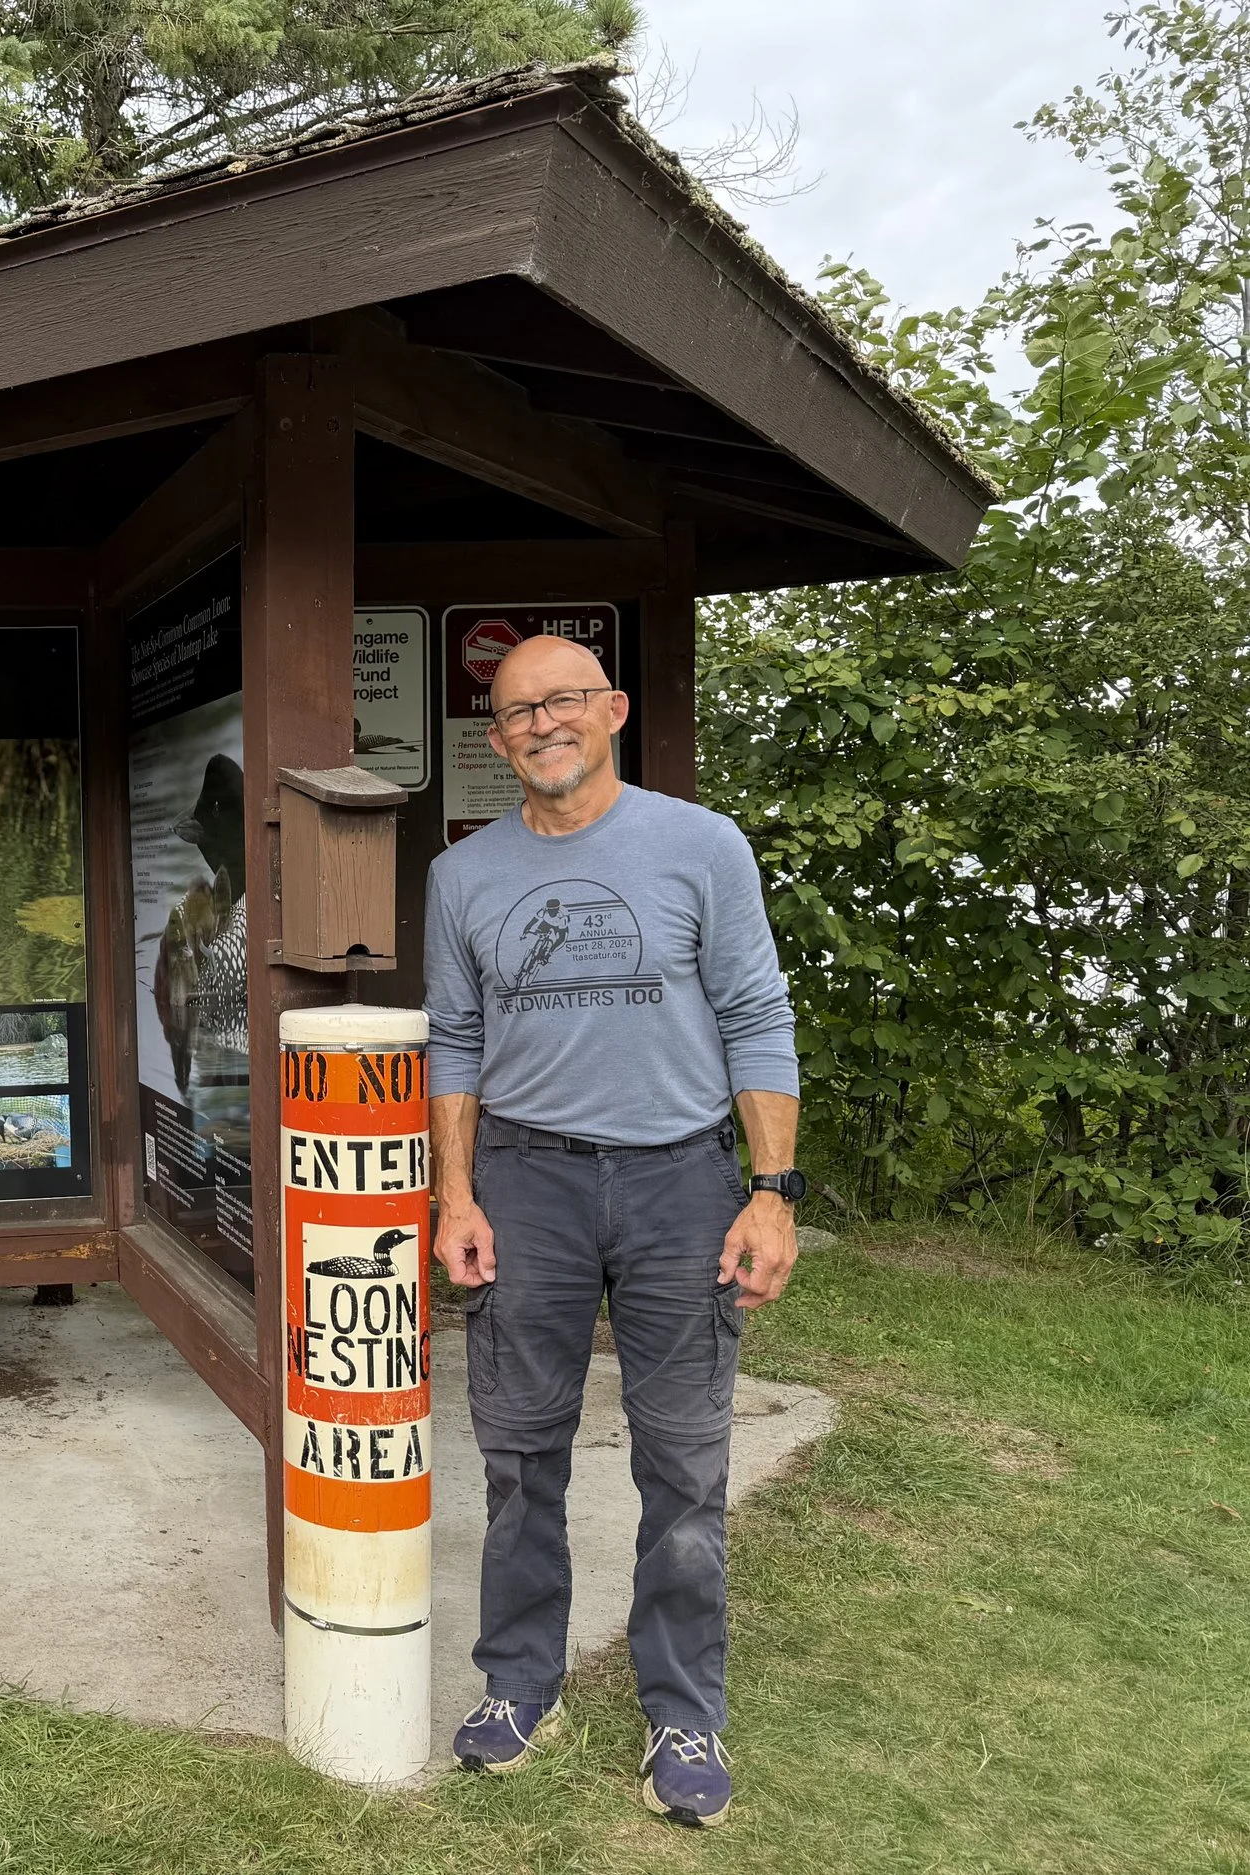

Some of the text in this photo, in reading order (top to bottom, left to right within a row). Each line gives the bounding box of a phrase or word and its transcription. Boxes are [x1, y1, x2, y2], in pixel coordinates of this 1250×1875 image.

[183, 607, 211, 635] Common
[212, 595, 231, 619] Loon:
[543, 619, 604, 639] HELP
[178, 638, 202, 663] Mantrap
[202, 624, 219, 650] Lake
[354, 632, 409, 648] ngame
[353, 667, 391, 682] Fund
[354, 685, 399, 703] roject
[462, 730, 488, 738] BEFOR
[458, 762, 487, 771] Dispose
[463, 823, 487, 831] Minne
[583, 913, 612, 928] 43rd
[579, 928, 619, 938] ANNUAL
[565, 939, 633, 953] Sept 28, 2024
[497, 988, 663, 1015] HEDWATERS 100
[285, 1052, 328, 1103] DO
[290, 1135, 425, 1191] ENTER
[305, 1278, 417, 1335] LOON
[287, 1322, 430, 1389] NESTING
[300, 1420, 424, 1480] AREA
